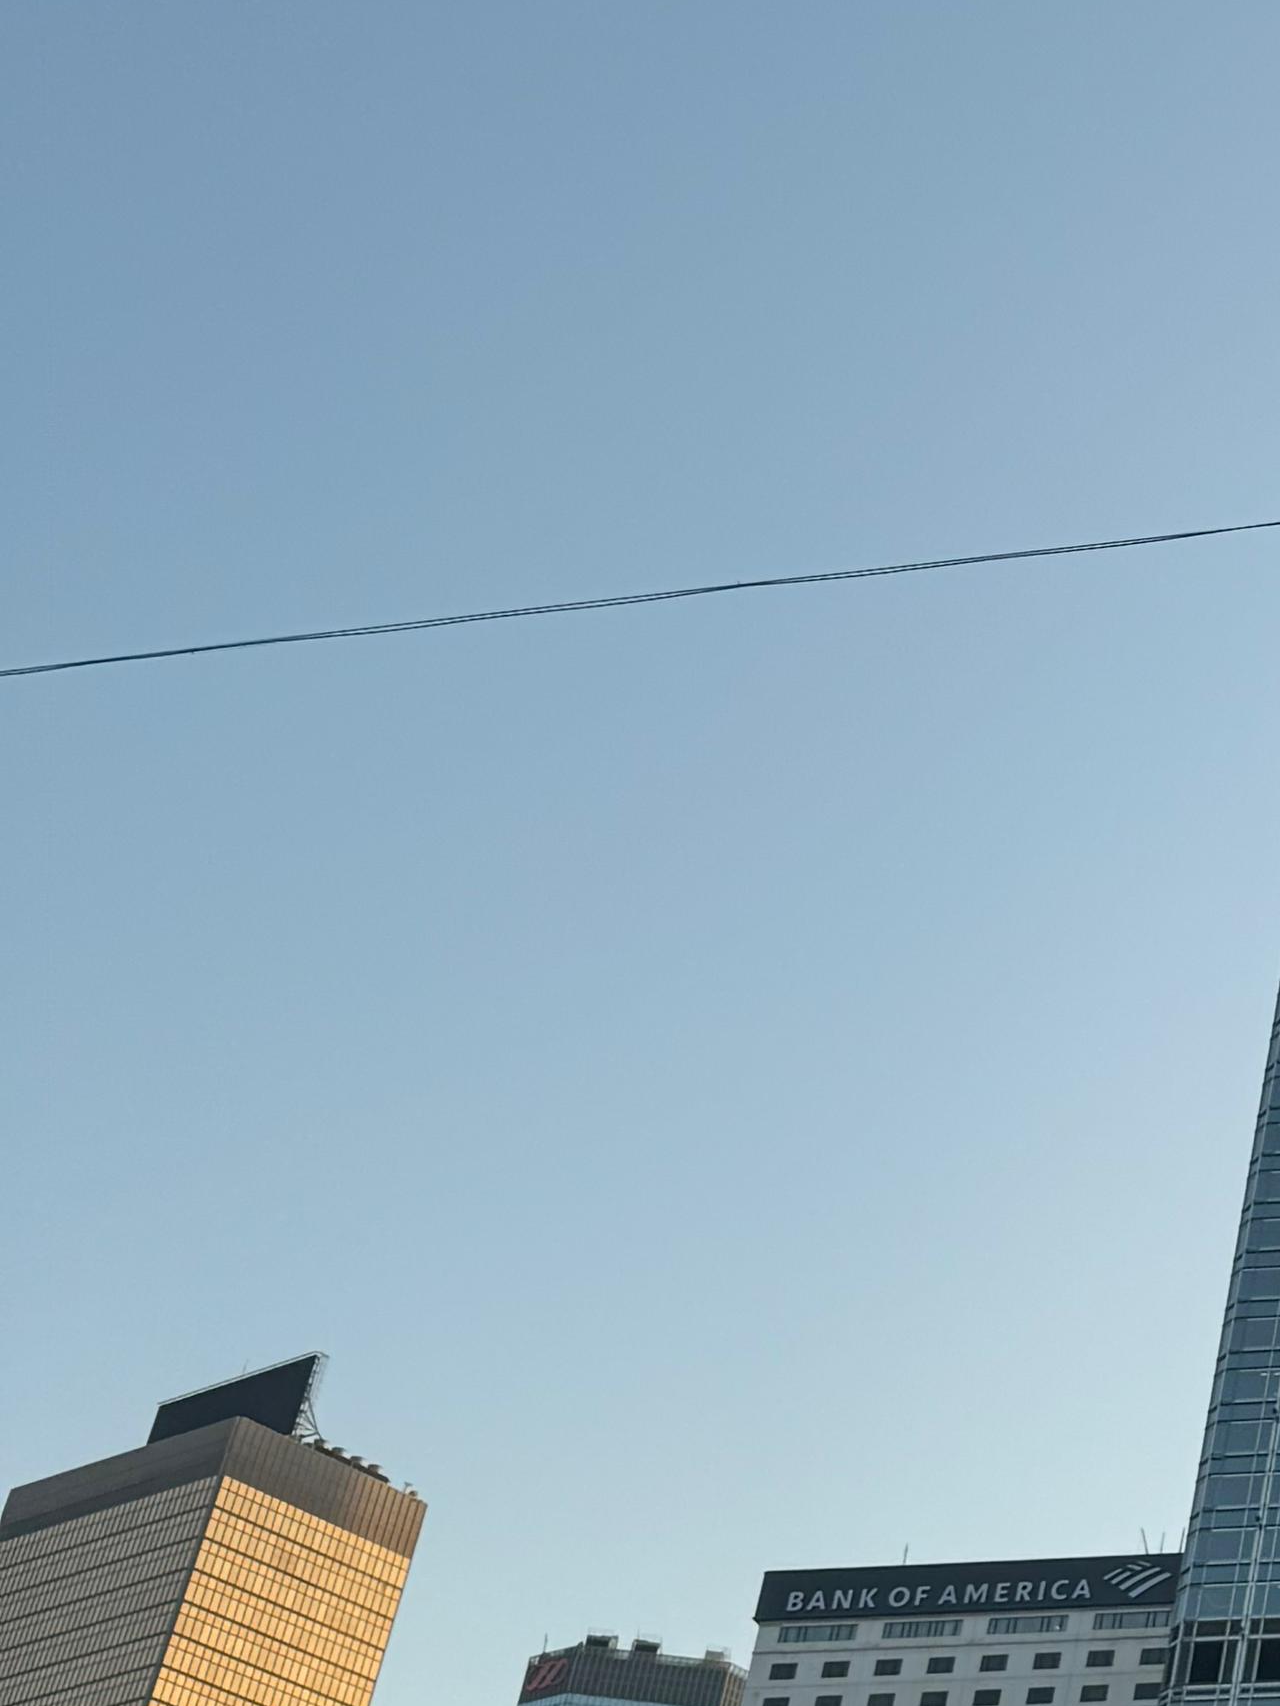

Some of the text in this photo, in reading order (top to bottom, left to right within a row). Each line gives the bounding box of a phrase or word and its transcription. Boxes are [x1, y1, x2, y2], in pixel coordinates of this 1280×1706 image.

[786, 1579, 1092, 1612] BANK OF AMERICA
